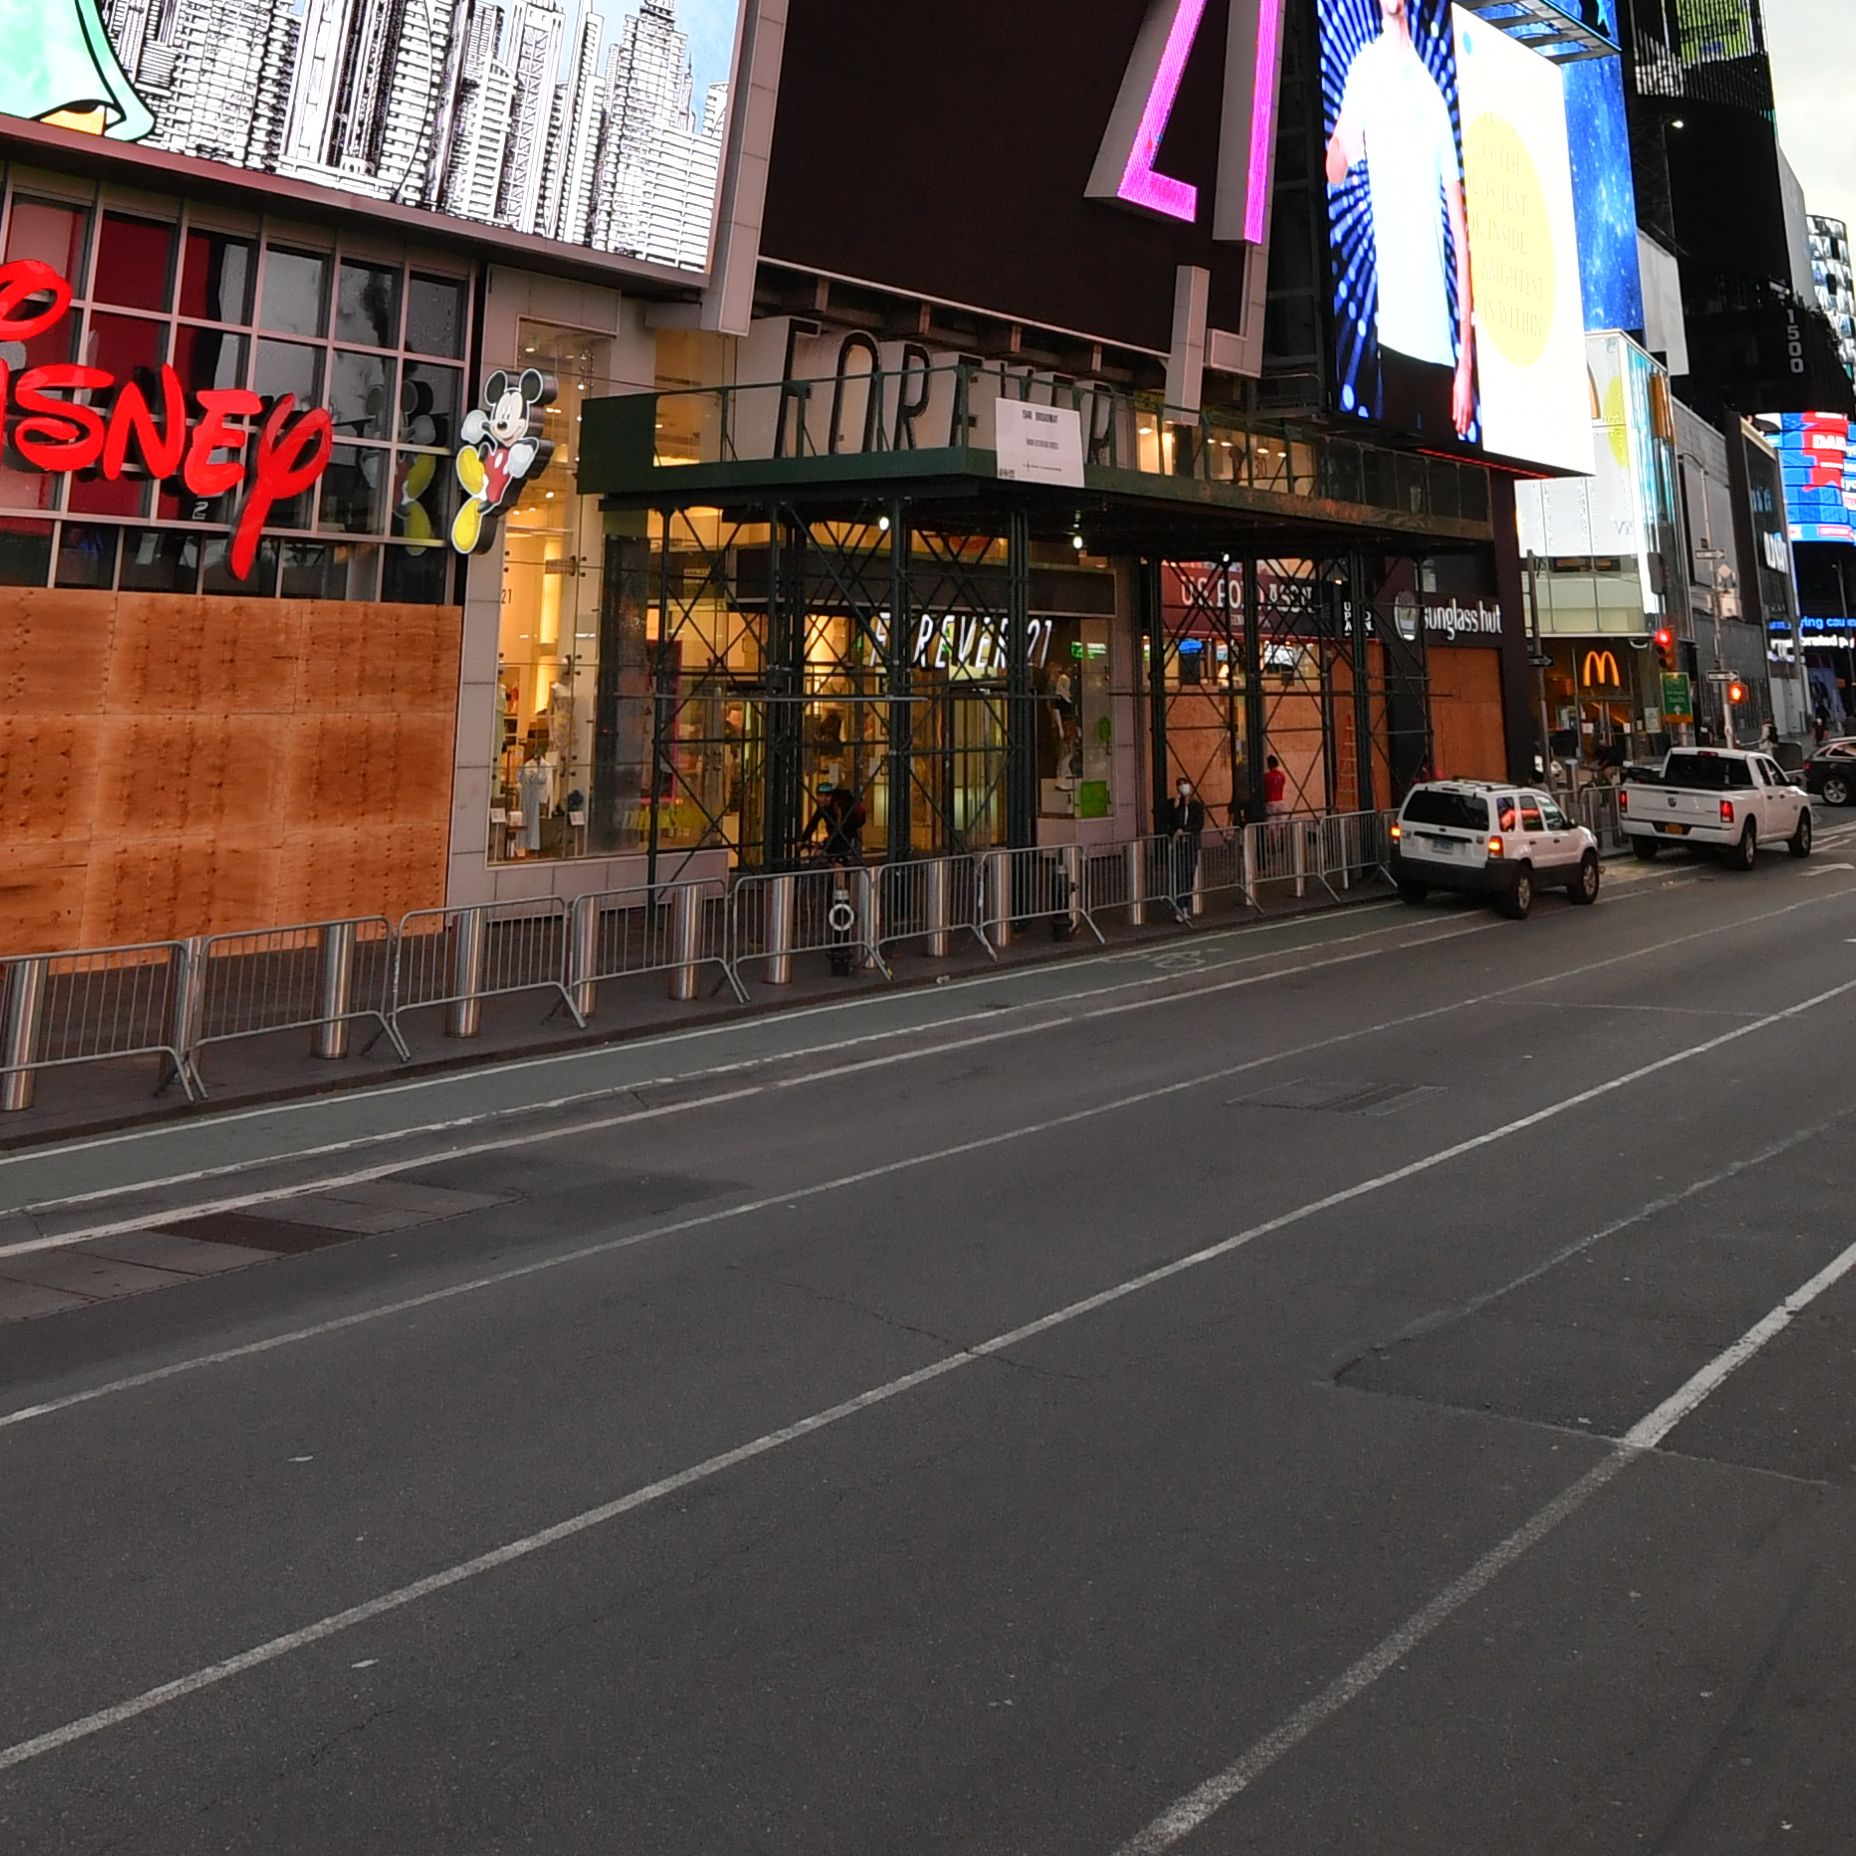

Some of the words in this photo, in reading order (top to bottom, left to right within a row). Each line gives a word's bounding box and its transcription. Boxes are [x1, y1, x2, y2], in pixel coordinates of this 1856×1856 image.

[1788, 307, 1805, 375] 1500
[1026, 618, 1053, 670] 21
[1424, 597, 1479, 642] sunglass
[1478, 600, 1503, 635] hut
